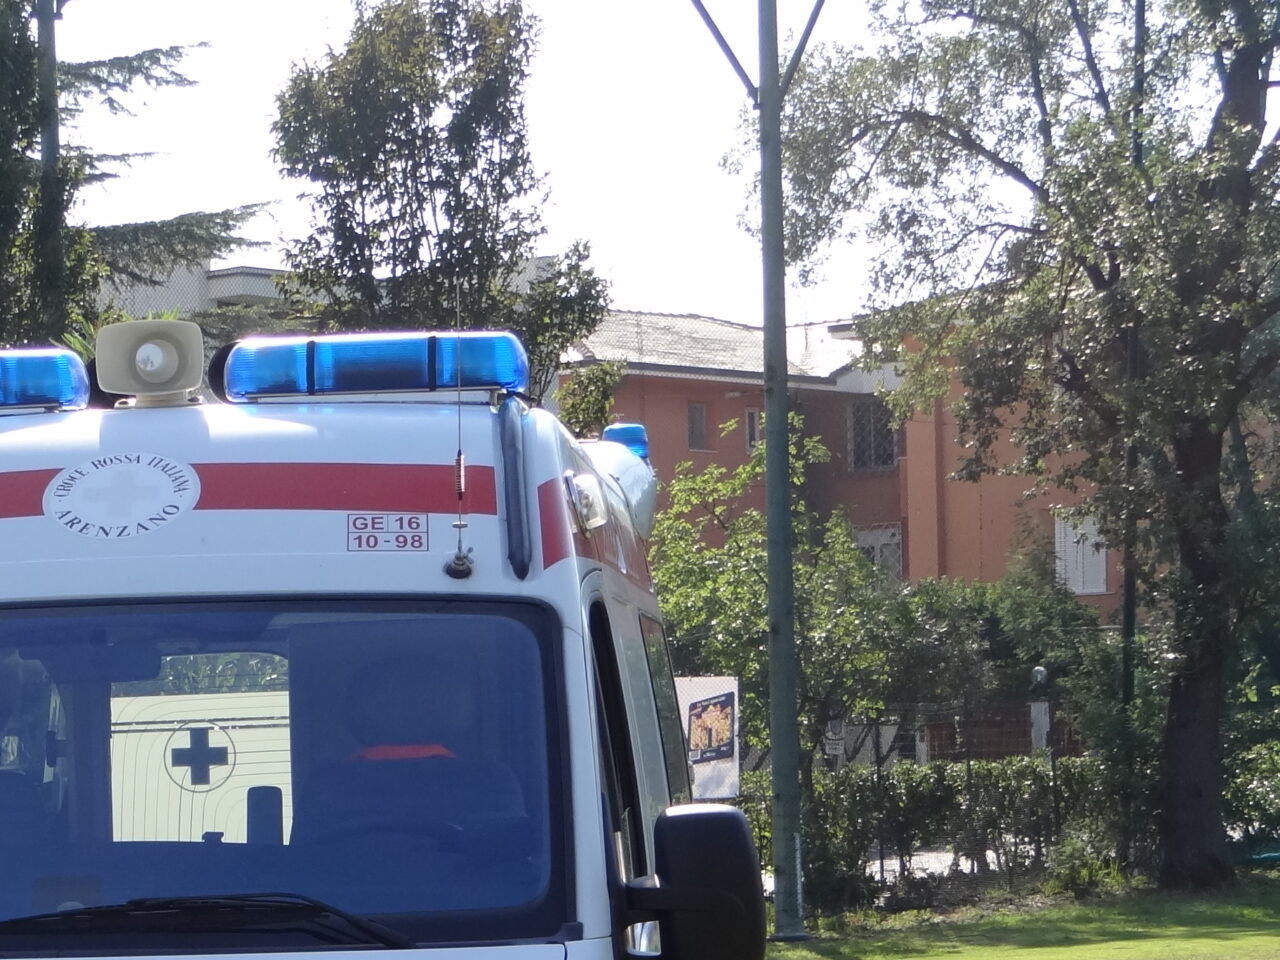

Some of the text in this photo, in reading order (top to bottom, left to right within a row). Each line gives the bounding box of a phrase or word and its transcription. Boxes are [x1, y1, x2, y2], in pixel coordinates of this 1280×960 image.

[53, 454, 190, 498] CROCE ROSSA ITALIANA
[54, 504, 180, 538] ARENZANO
[352, 516, 421, 530] GE 16
